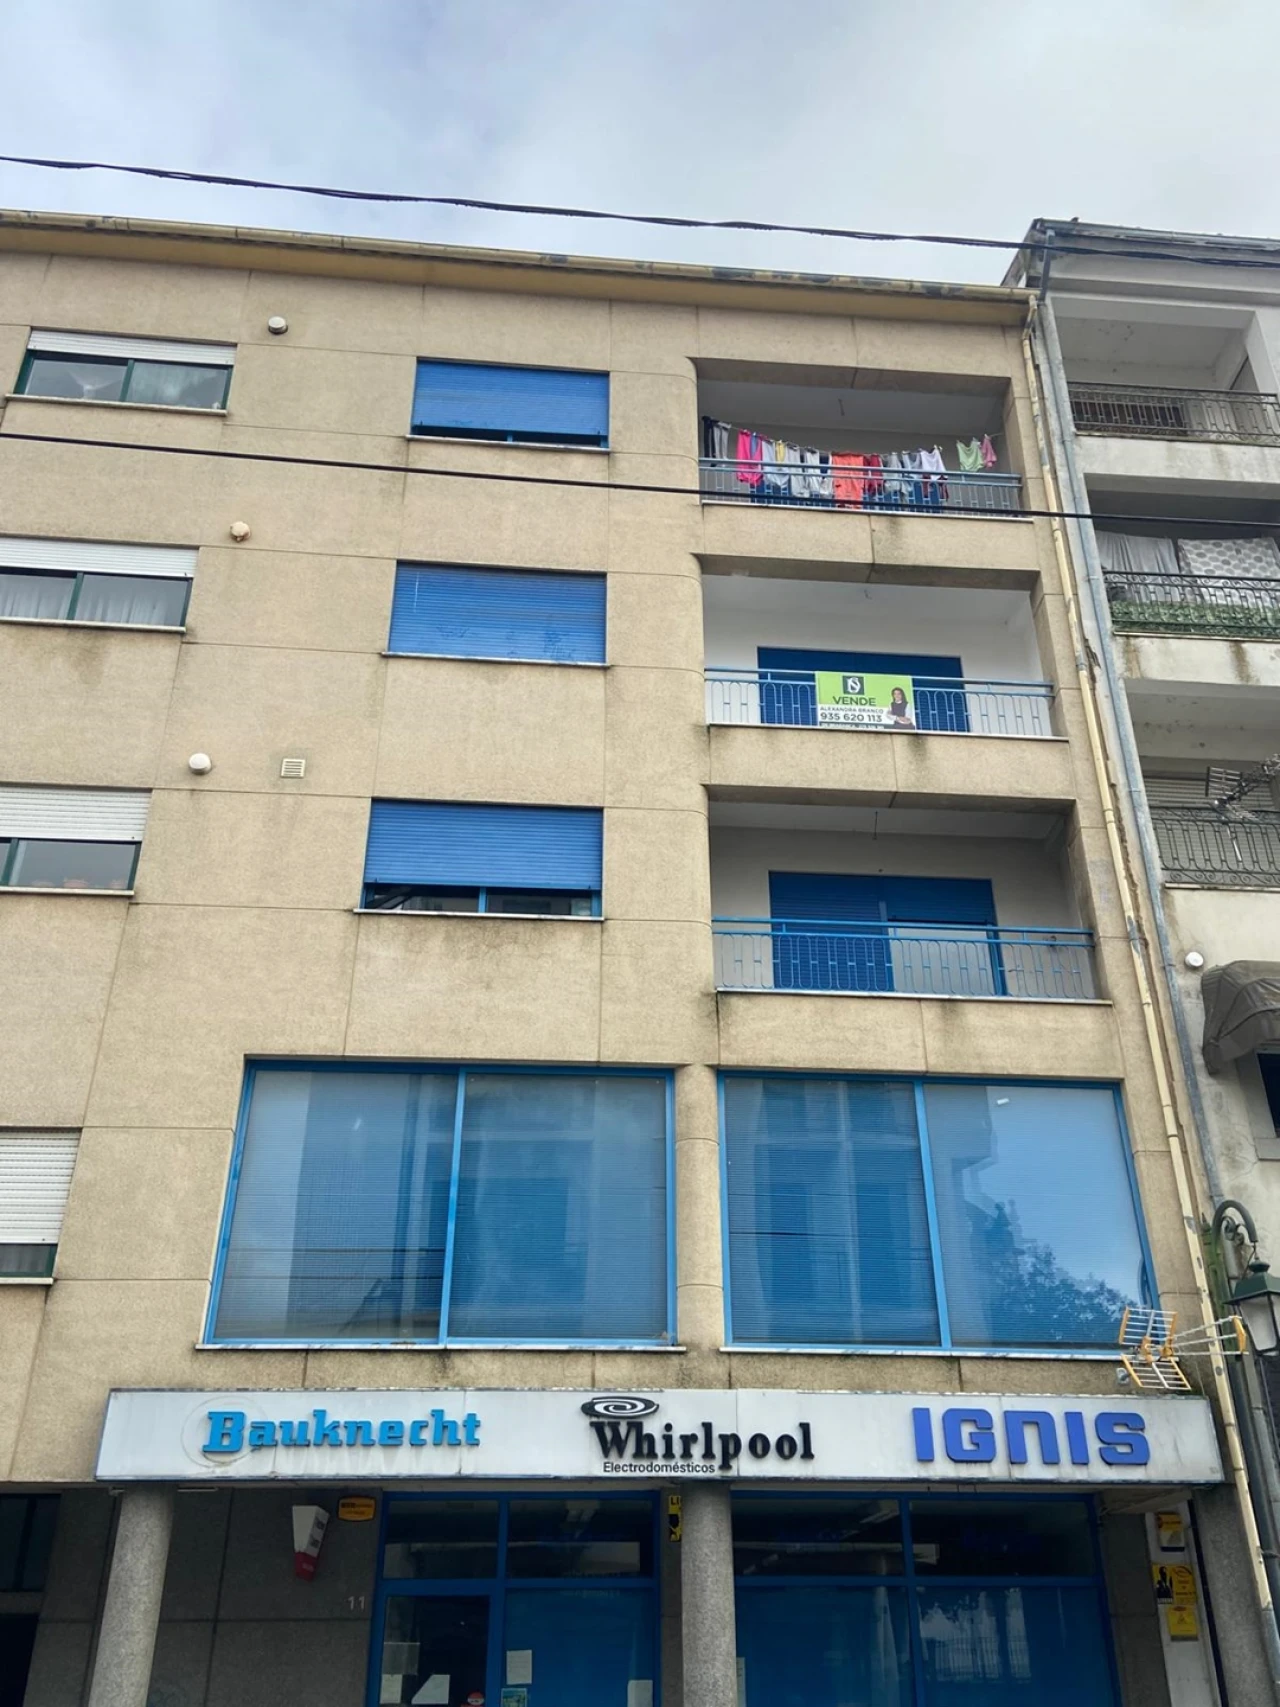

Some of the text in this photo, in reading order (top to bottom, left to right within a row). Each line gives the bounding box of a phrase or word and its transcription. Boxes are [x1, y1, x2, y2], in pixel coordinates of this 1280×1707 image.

[833, 696, 877, 706] VENDE
[820, 713, 882, 723] 935 620 113
[202, 1409, 480, 1453] Bauknecht
[912, 1407, 1151, 1465] IGNIS
[590, 1420, 814, 1470] Whirlpool
[603, 1461, 715, 1475] Electrodomésticos
[347, 1595, 365, 1611] 11
